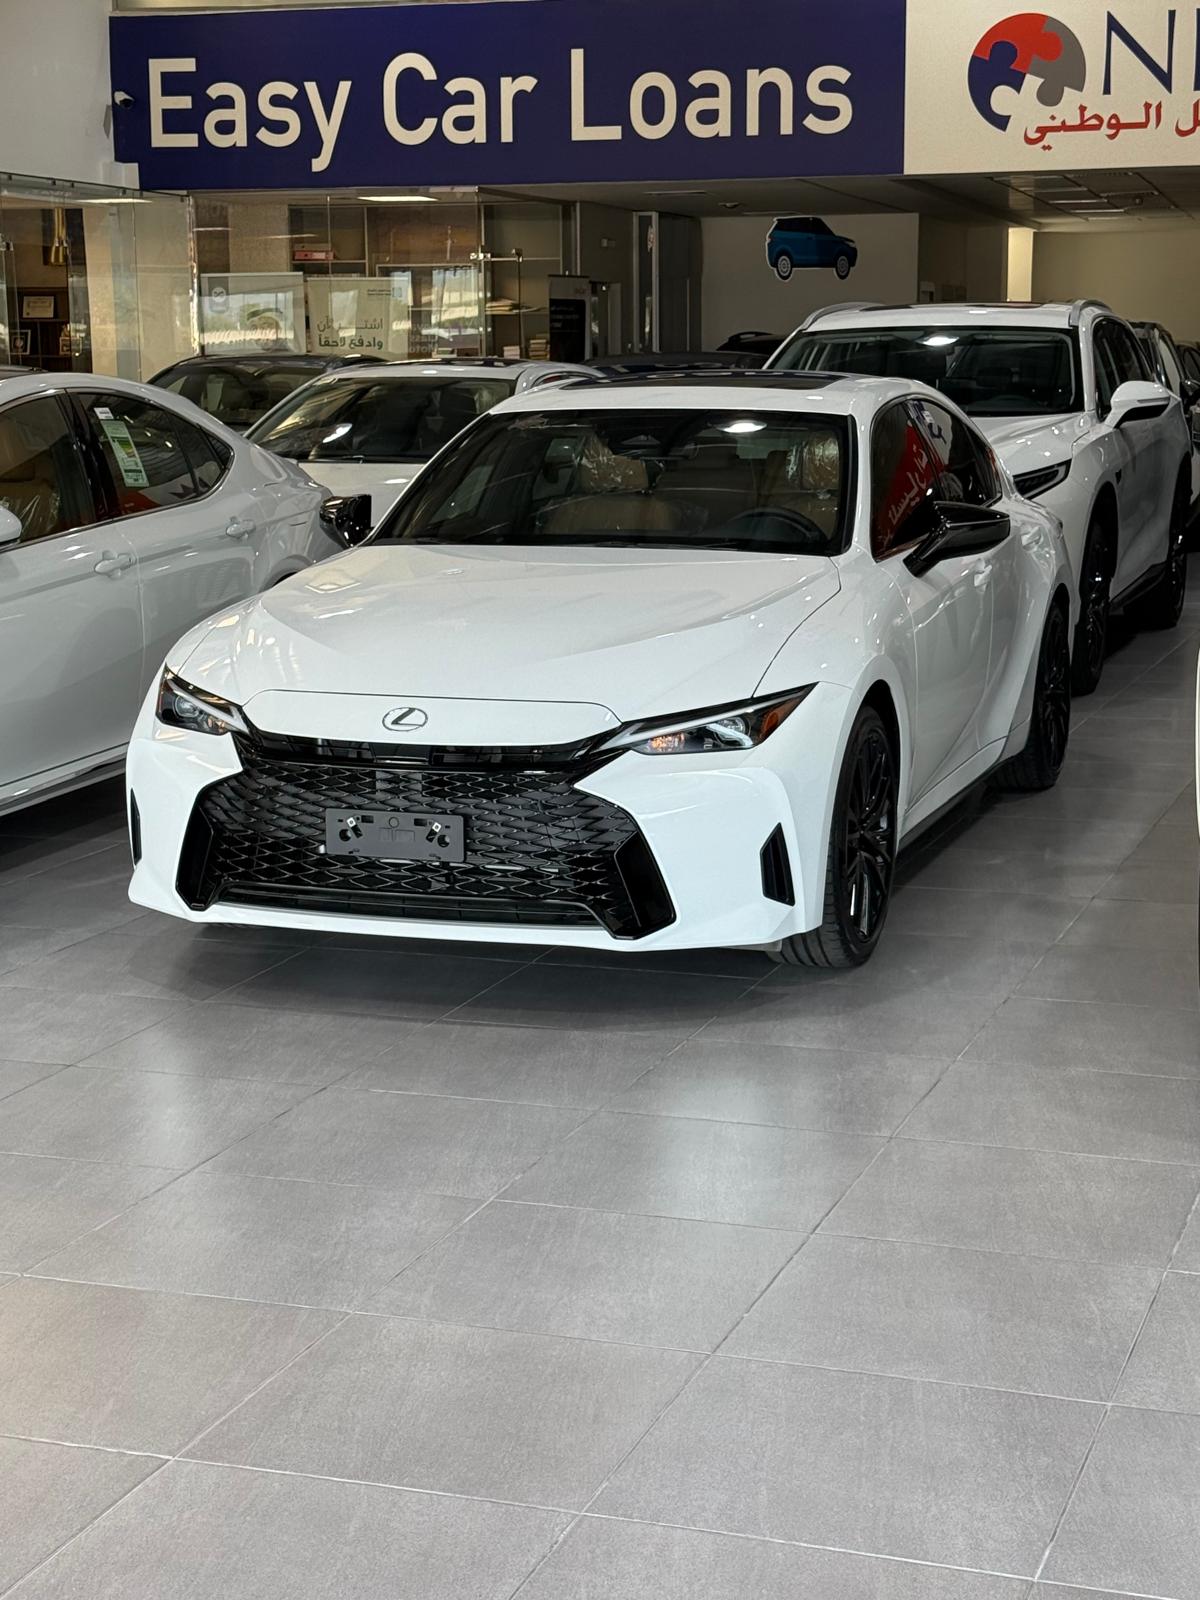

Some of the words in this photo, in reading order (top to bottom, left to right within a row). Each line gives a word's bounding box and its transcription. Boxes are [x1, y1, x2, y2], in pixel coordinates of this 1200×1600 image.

[1102, 7, 1200, 96] N
[147, 57, 352, 172] Easy
[383, 52, 538, 146] Car
[570, 48, 853, 141] Loans
[1023, 100, 1162, 151] الوطني
[348, 335, 384, 351] وادفع
